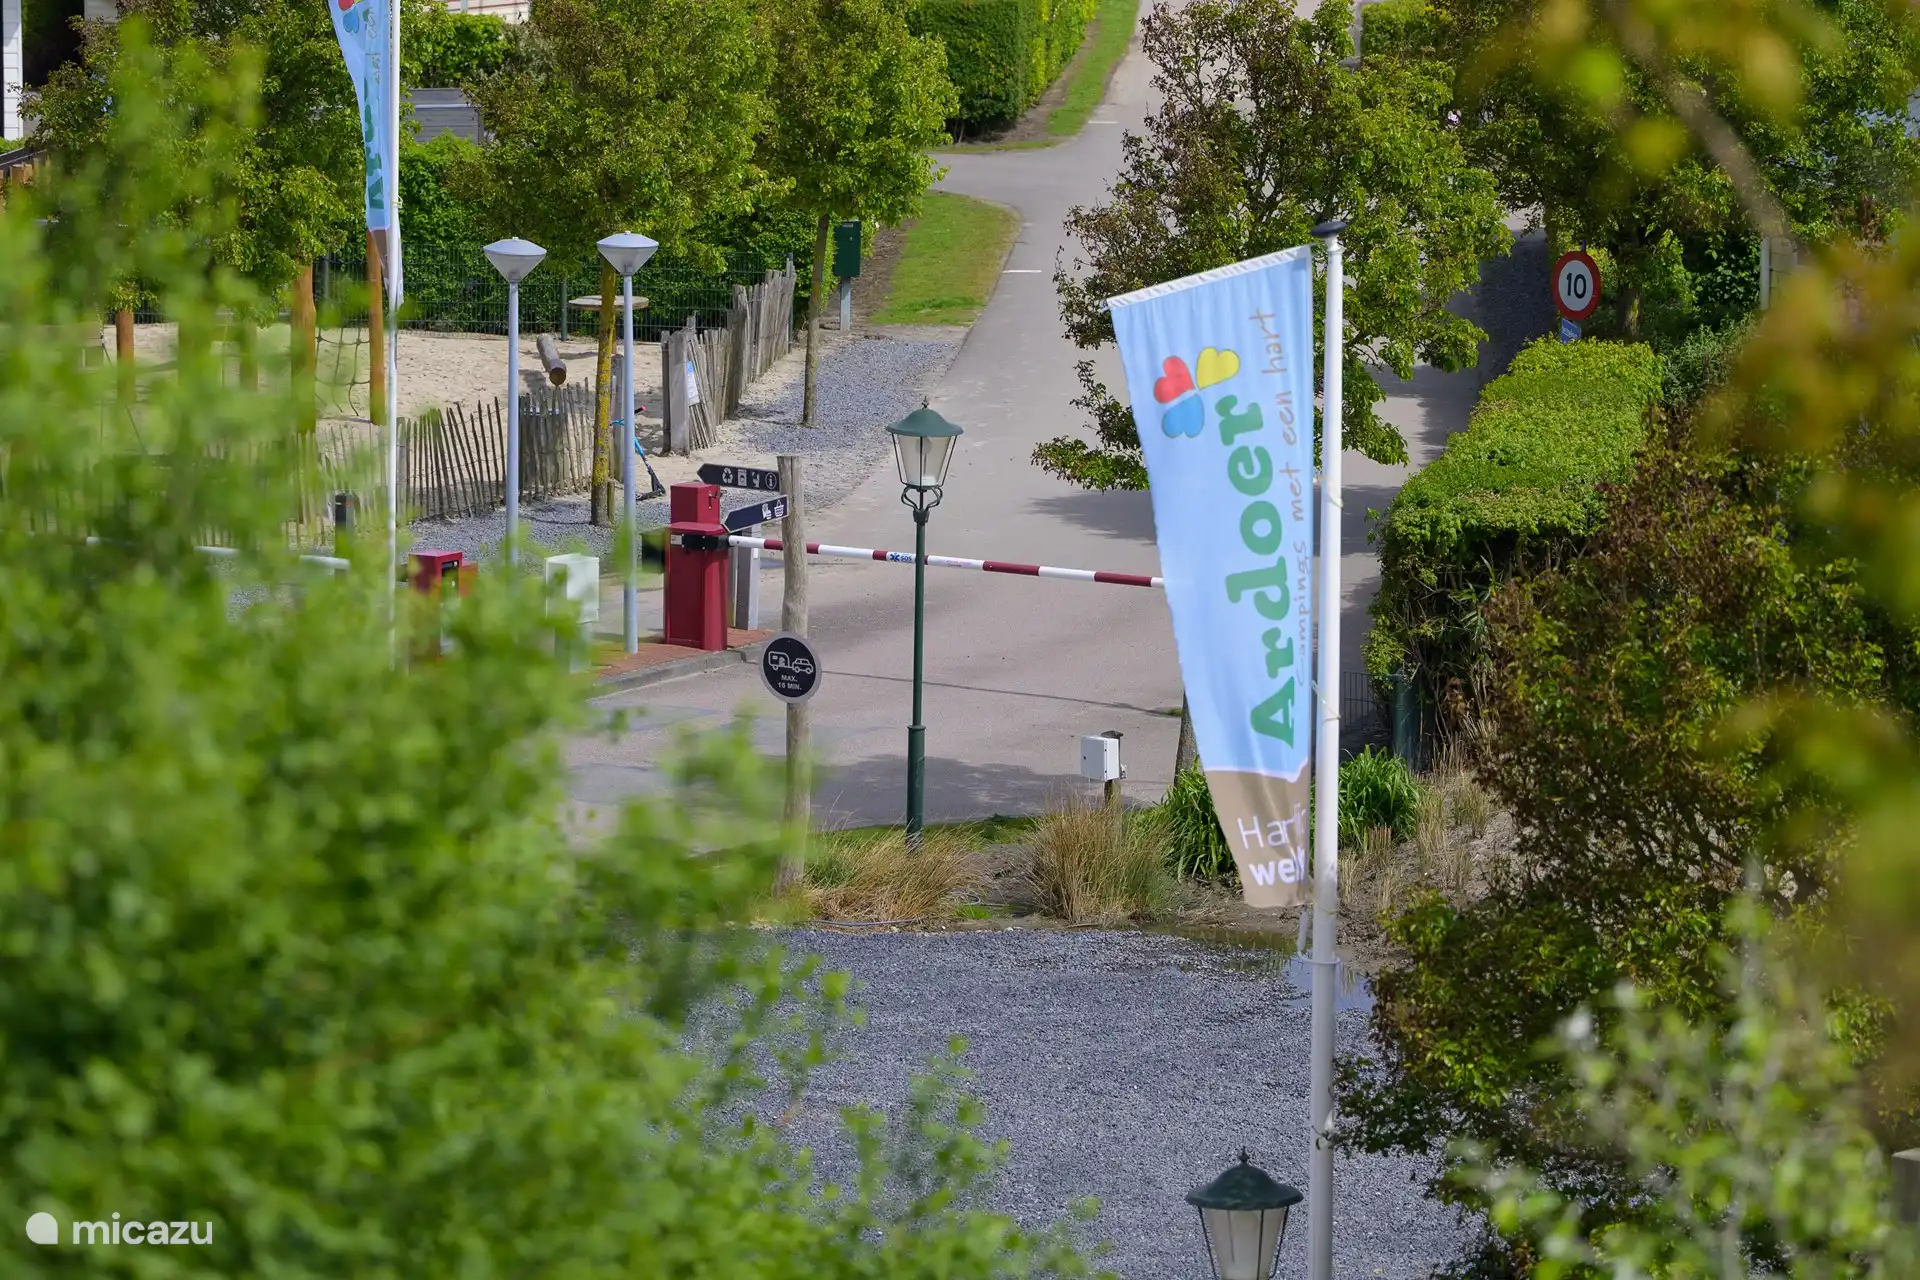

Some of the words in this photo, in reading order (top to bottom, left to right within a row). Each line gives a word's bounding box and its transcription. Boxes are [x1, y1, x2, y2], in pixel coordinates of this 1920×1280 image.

[1566, 272, 1587, 299] 10
[1248, 308, 1288, 374] hart
[1275, 390, 1297, 446] een
[1279, 461, 1304, 522] met
[1215, 394, 1295, 750] Ardoer
[781, 674, 798, 682] MAX.
